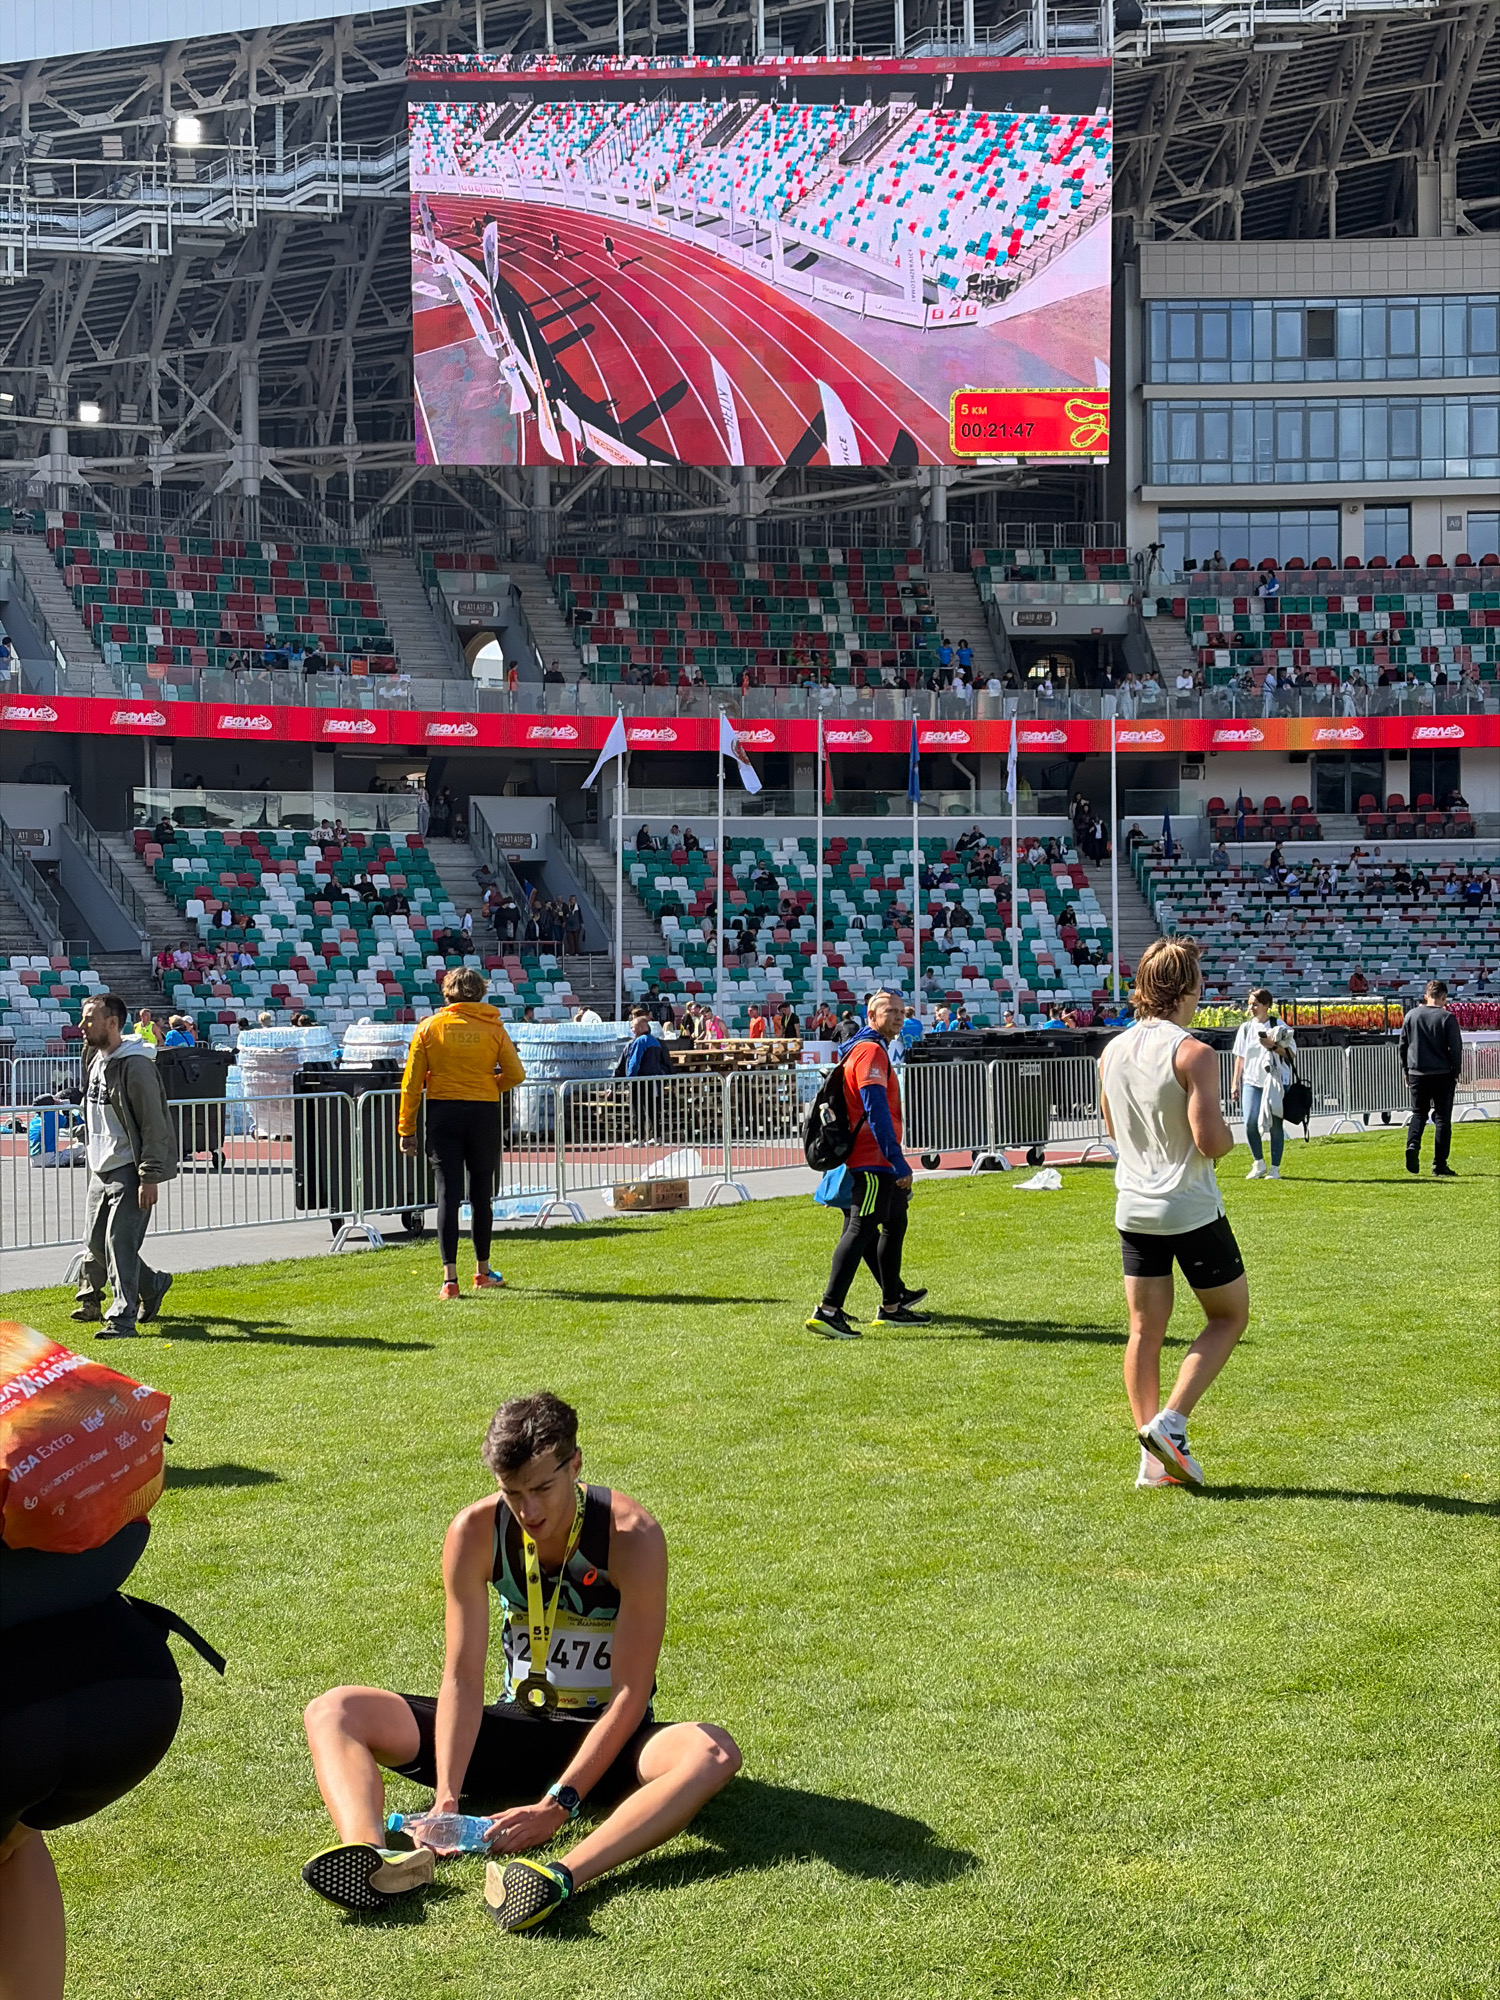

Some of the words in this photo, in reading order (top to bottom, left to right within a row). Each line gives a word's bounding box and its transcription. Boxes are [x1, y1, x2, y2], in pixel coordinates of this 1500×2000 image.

[960, 404, 968, 415] 5
[961, 423, 1035, 438] 00:21:47
[4, 707, 44, 721] БФЛА
[113, 711, 152, 725] БФЛА
[220, 715, 258, 729] БФЛА
[326, 720, 363, 733] БФЛА
[428, 723, 464, 737] БФЛА
[529, 726, 565, 739] БФЛА
[630, 728, 664, 741] БФЛА
[1214, 730, 1252, 742] БФЛА
[1315, 729, 1352, 741] БФЛА
[1415, 726, 1453, 739] БФЛА
[826, 731, 860, 743] БФЛА
[921, 731, 957, 743] БФЛА
[1020, 731, 1055, 743] БФЛА
[1116, 731, 1153, 743] БФЛА
[797, 767, 813, 775] A10
[451, 1032, 481, 1043] 1528
[8, 1454, 41, 1483] VISA
[36, 1433, 75, 1459] Extra
[533, 1626, 542, 1636] 5
